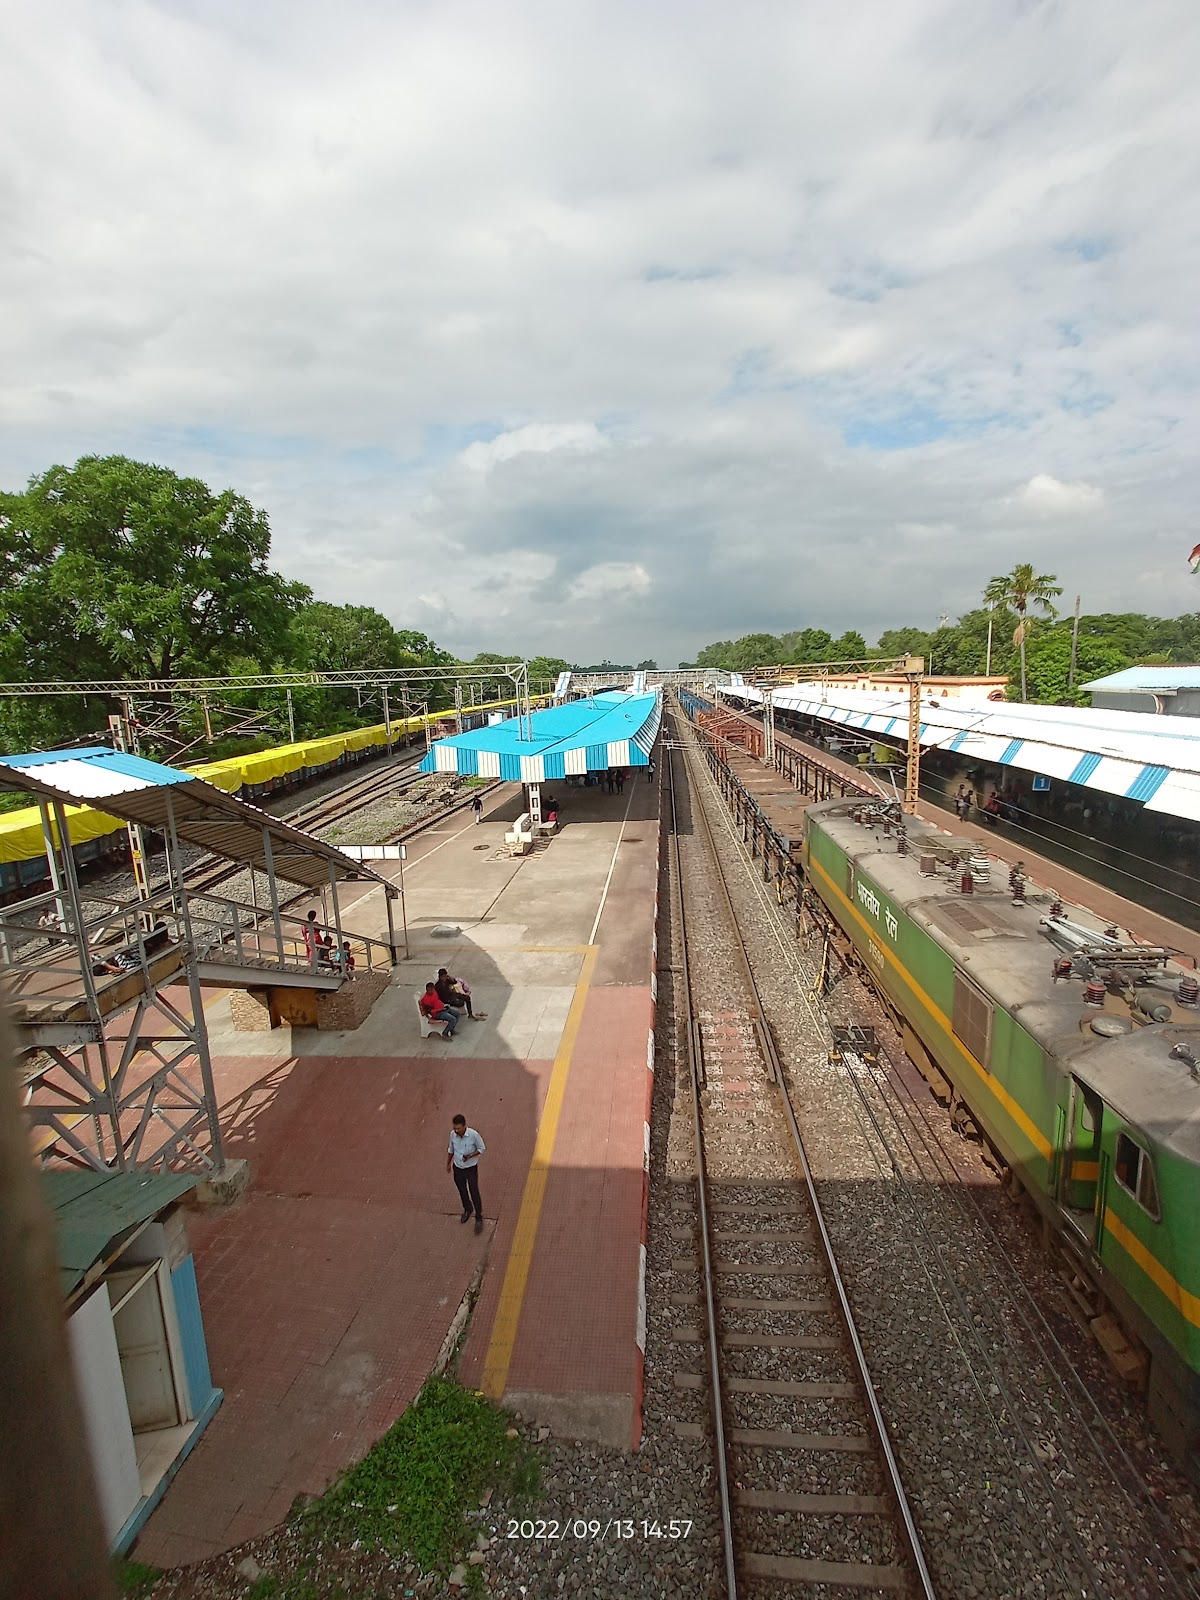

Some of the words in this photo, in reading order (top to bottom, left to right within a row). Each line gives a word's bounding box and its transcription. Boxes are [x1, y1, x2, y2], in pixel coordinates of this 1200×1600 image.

[1040, 777, 1046, 788] 1
[857, 880, 881, 920] भारतीय
[885, 906, 898, 942] रेल
